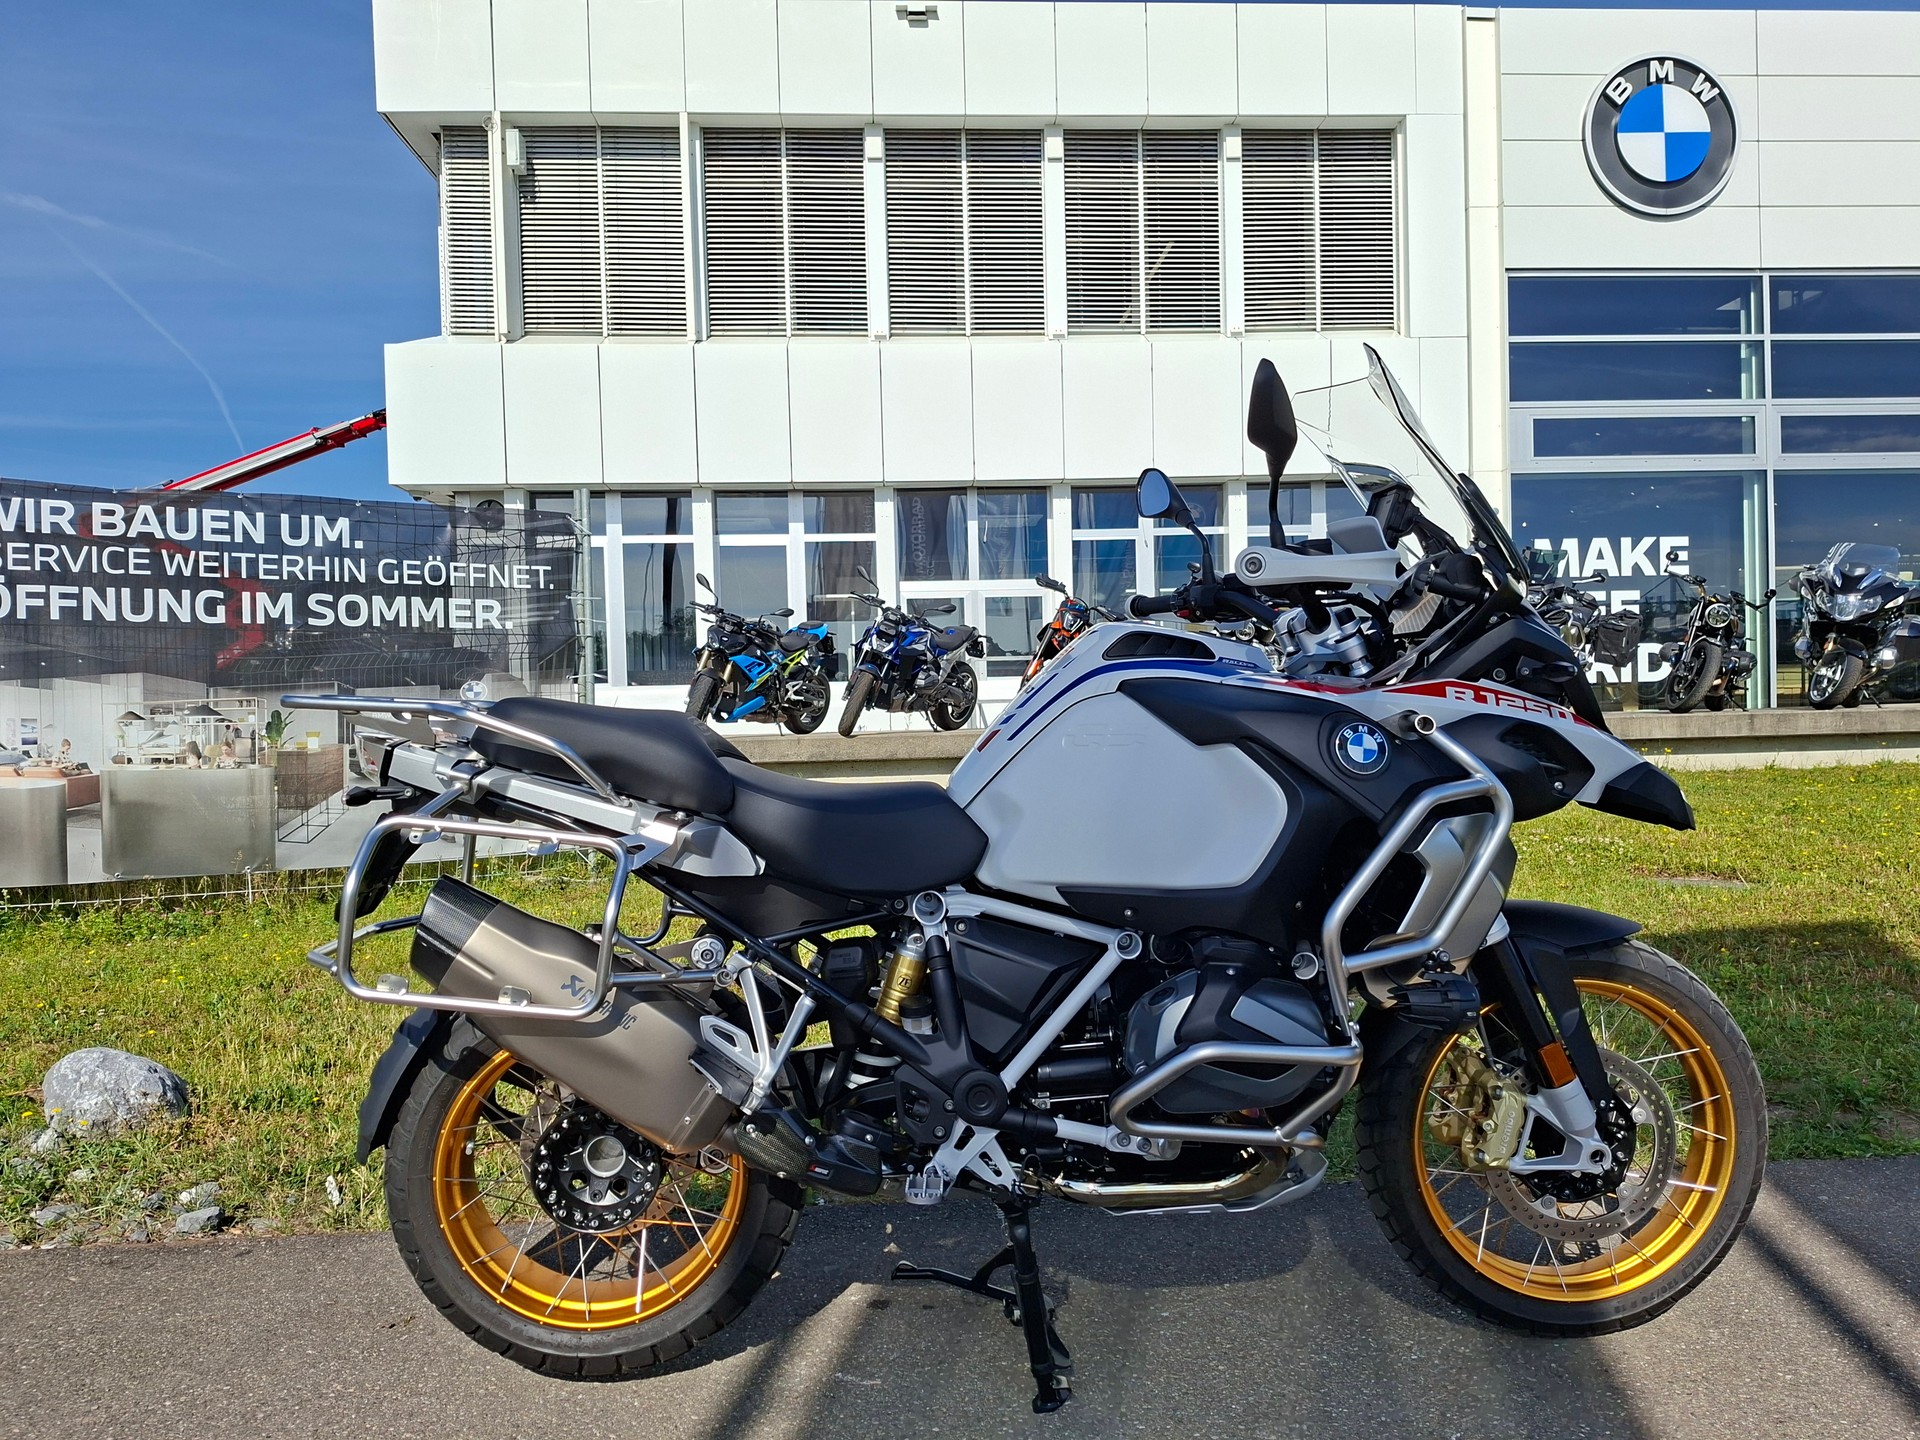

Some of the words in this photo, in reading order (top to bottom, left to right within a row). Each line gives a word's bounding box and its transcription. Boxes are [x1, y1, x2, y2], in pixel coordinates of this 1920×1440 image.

[1605, 60, 1720, 105] BMW
[92, 502, 266, 544] BAUEN
[280, 513, 364, 549] UM.
[0, 542, 151, 576] ERVICE
[161, 550, 366, 583] WEITERHIN
[377, 555, 555, 590] GEÖFFNET.
[1534, 536, 1690, 577] MAKE
[241, 593, 294, 624] IM
[307, 593, 514, 629] SOMMER.
[1343, 725, 1383, 743] BMW
[898, 976, 911, 987] ZF
[1498, 1110, 1516, 1154] brembo
